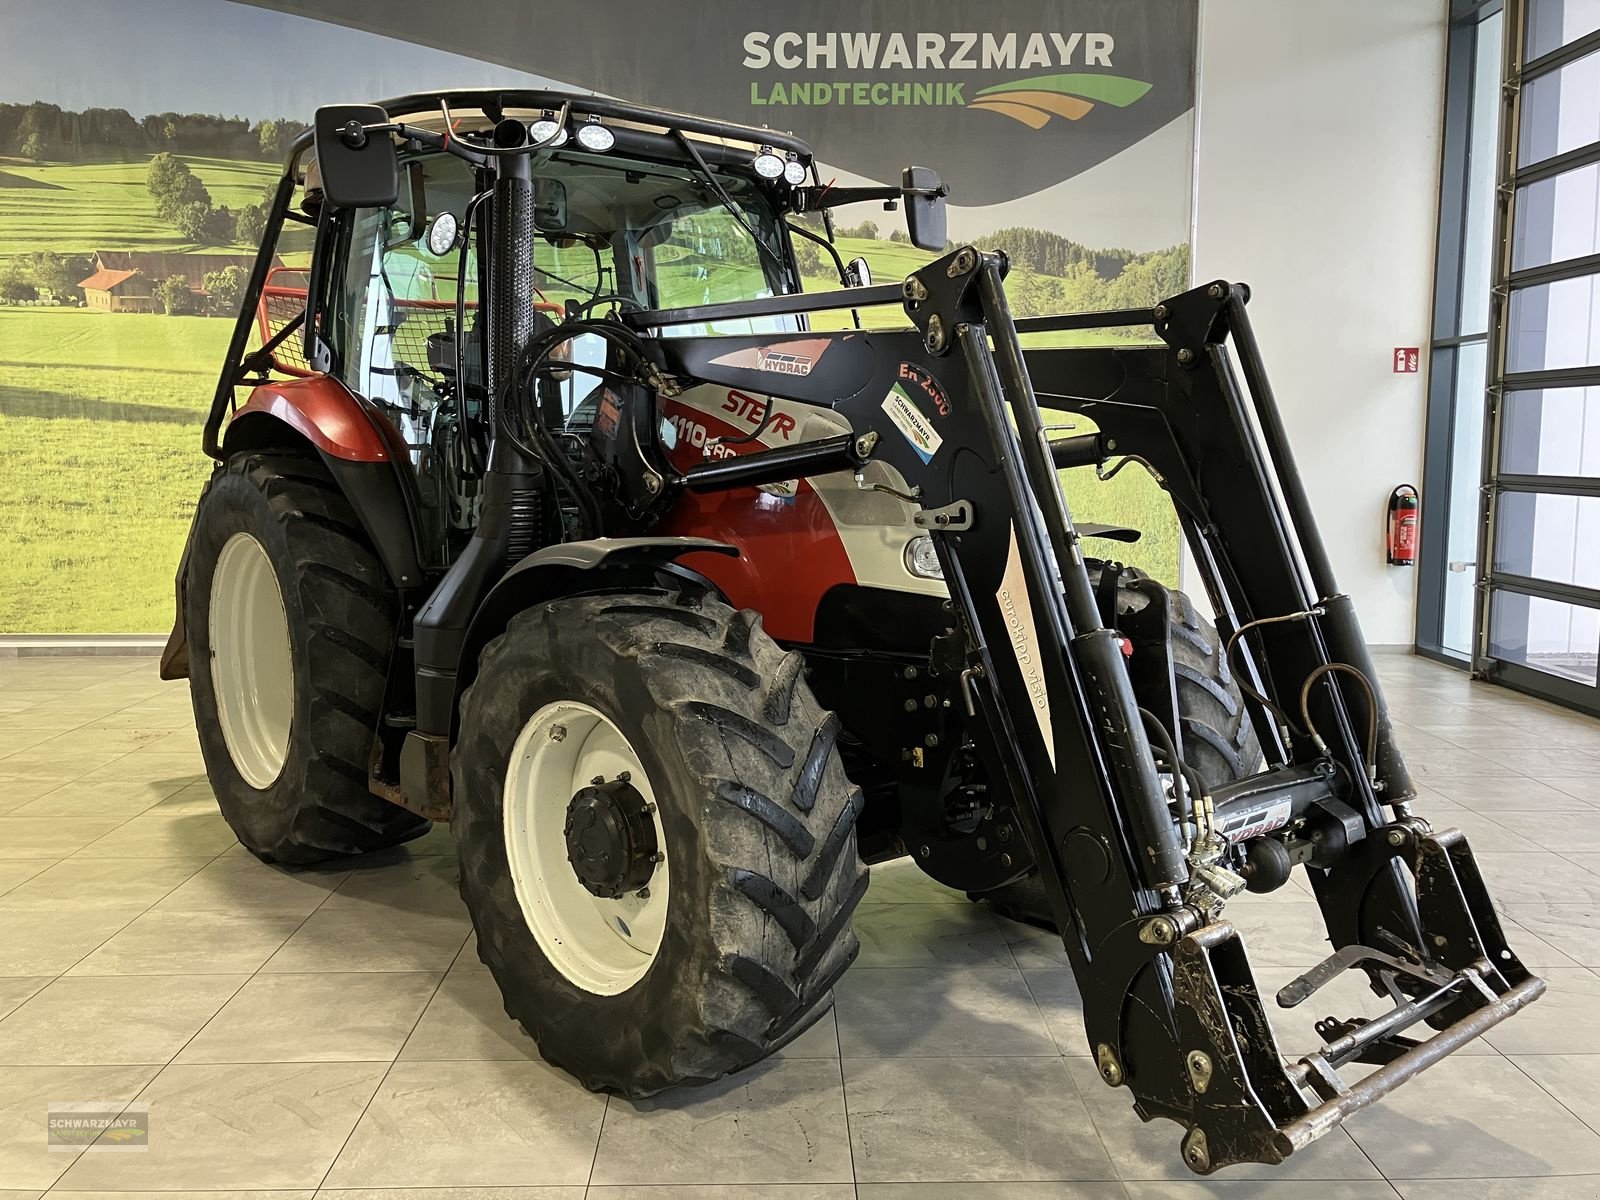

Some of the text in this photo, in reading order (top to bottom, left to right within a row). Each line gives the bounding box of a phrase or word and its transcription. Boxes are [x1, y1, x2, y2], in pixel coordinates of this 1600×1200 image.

[742, 31, 1115, 69] SCHWARZMAYR
[750, 82, 966, 106] LANDTECHNIK
[765, 359, 809, 375] HYDRAC
[899, 363, 918, 382] En
[721, 389, 796, 441] STEYR
[894, 395, 930, 441] SCHWARZMAYR
[1000, 588, 1032, 666] eurokipp
[1227, 816, 1286, 843] YDRAC
